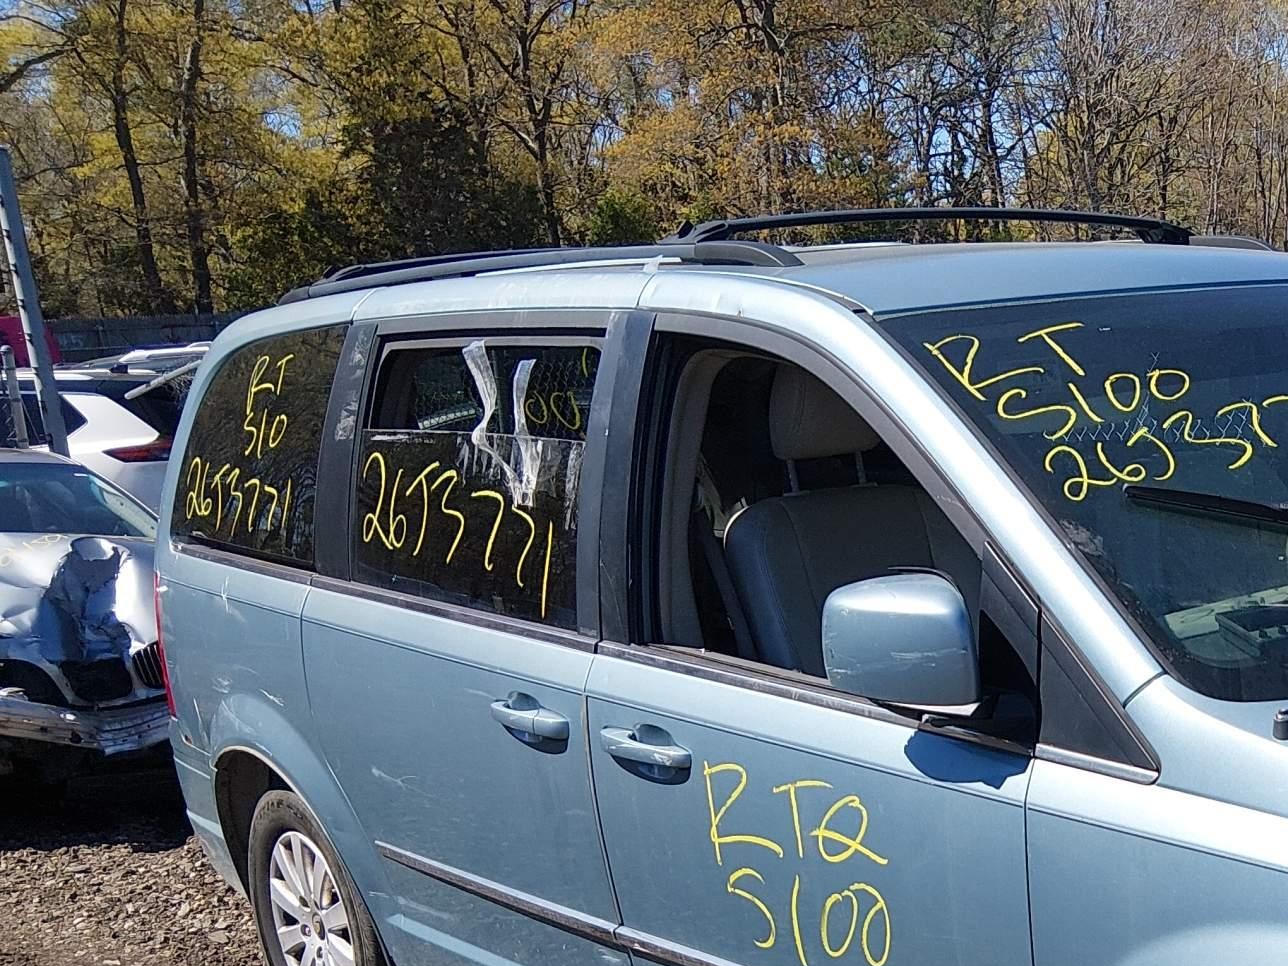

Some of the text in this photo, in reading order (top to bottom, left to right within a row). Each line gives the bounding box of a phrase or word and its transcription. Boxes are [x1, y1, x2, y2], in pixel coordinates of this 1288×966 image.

[245, 354, 295, 412] RT
[997, 368, 1190, 439] S100
[703, 760, 889, 866] RTQ
